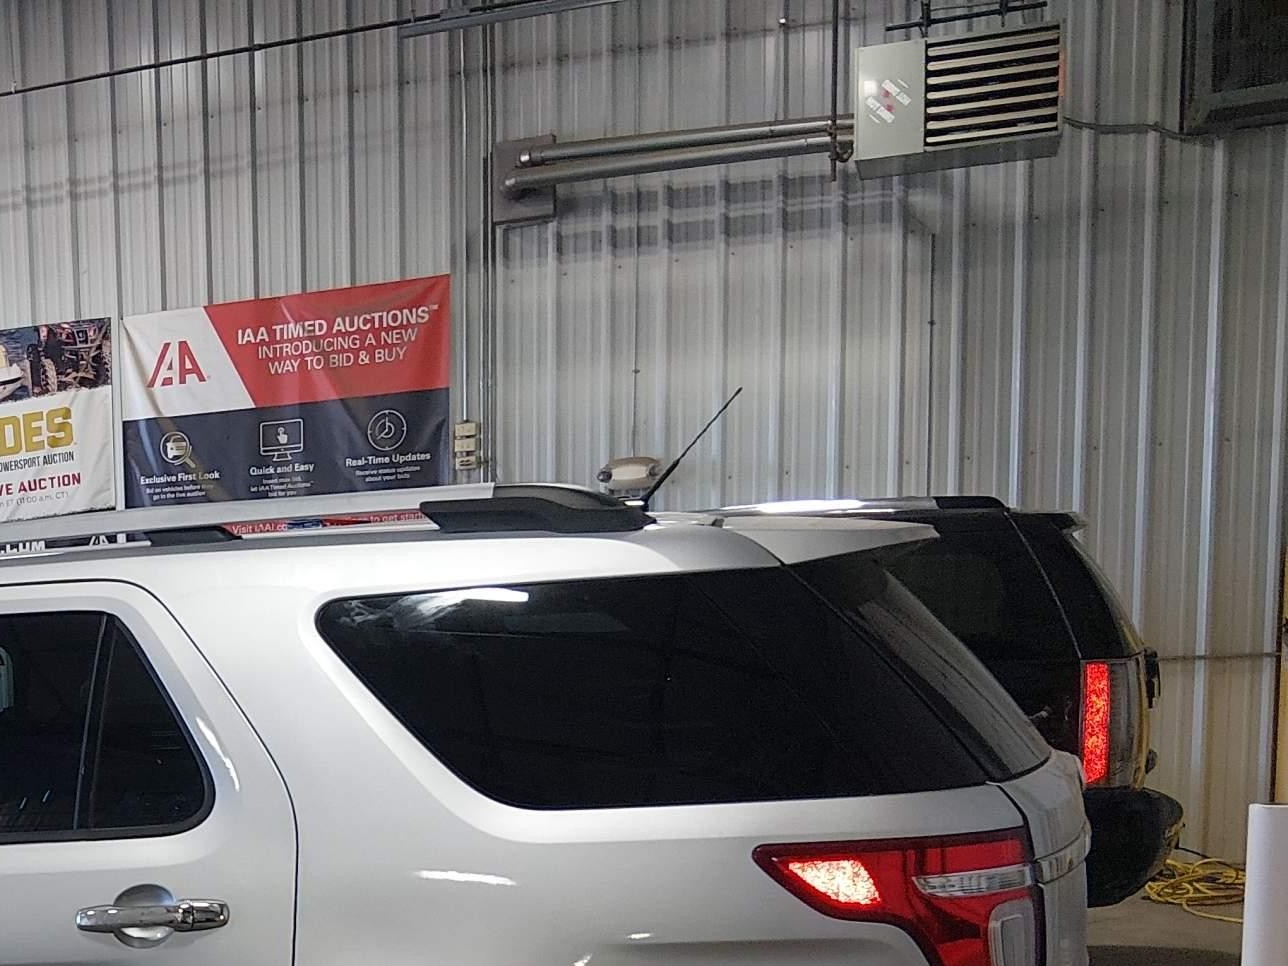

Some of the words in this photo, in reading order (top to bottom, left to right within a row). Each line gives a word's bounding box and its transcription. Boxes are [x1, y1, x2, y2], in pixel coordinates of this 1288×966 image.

[237, 327, 269, 345] IAA
[272, 319, 328, 341] TIMED
[258, 332, 361, 360] INTRODUCING
[364, 332, 377, 346] A
[380, 327, 419, 345] NEW
[268, 358, 300, 375] WAY
[304, 356, 325, 371] TO
[329, 352, 355, 368] BID
[358, 351, 370, 365] &
[375, 346, 409, 363] BUY
[42, 452, 75, 467] AUCTION
[345, 456, 390, 467] Real-Time
[392, 452, 431, 464] Updates
[140, 474, 176, 485] Exclusive
[177, 472, 196, 482] First
[198, 470, 221, 480] Look
[250, 465, 275, 477] Quick
[277, 464, 293, 474] and
[294, 463, 315, 474] Easy
[18, 471, 82, 494] AUCTION
[231, 525, 253, 535] Visit
